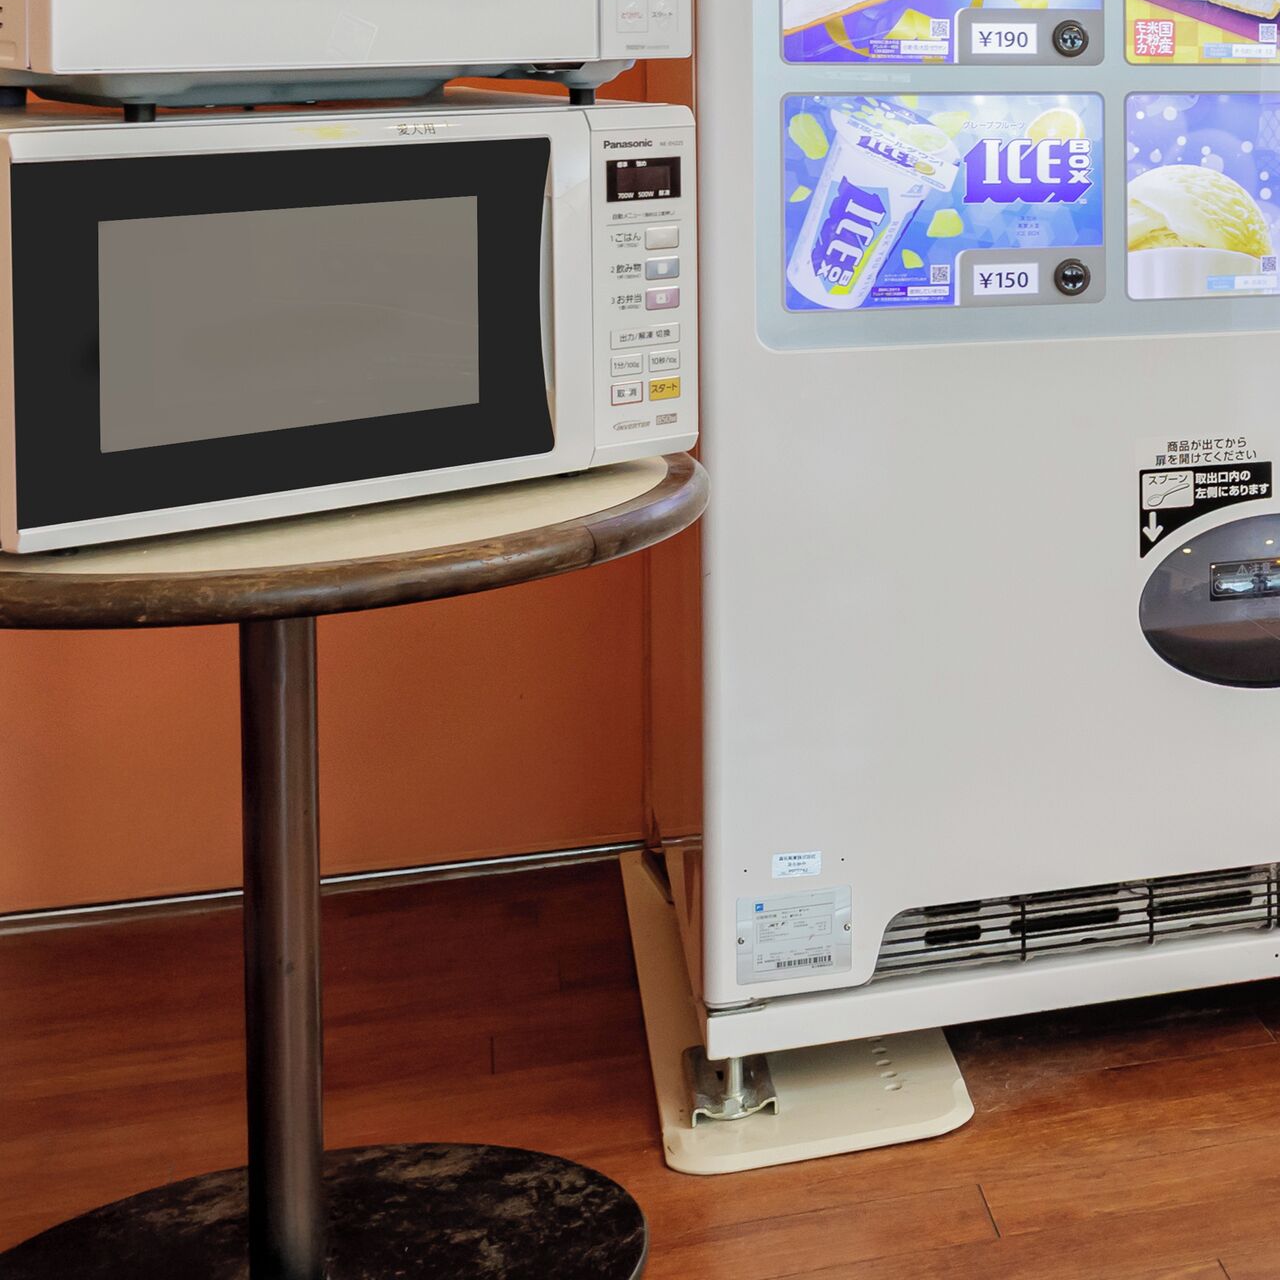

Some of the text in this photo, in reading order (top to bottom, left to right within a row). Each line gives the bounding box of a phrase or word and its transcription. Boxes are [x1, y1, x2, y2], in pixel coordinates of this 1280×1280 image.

[979, 31, 1028, 48] ¥190
[1136, 22, 1147, 54] モナカ
[1158, 22, 1173, 54] 国産
[603, 138, 653, 149] Panasonic
[983, 140, 1062, 184] ICE
[1067, 140, 1091, 183] BOX
[615, 232, 641, 242] ごはん
[825, 199, 886, 274] ICE
[616, 263, 642, 274] 飲み物
[979, 271, 1028, 288] ¥150
[617, 294, 642, 304] お弁当
[652, 383, 678, 393] スタート
[1167, 436, 1247, 452] 商品が出てから
[1155, 450, 1257, 466] 扉を開けてください
[1148, 474, 1188, 485] スプーン
[1195, 470, 1251, 484] 取出口内の
[1195, 483, 1269, 499] 左側にあります
